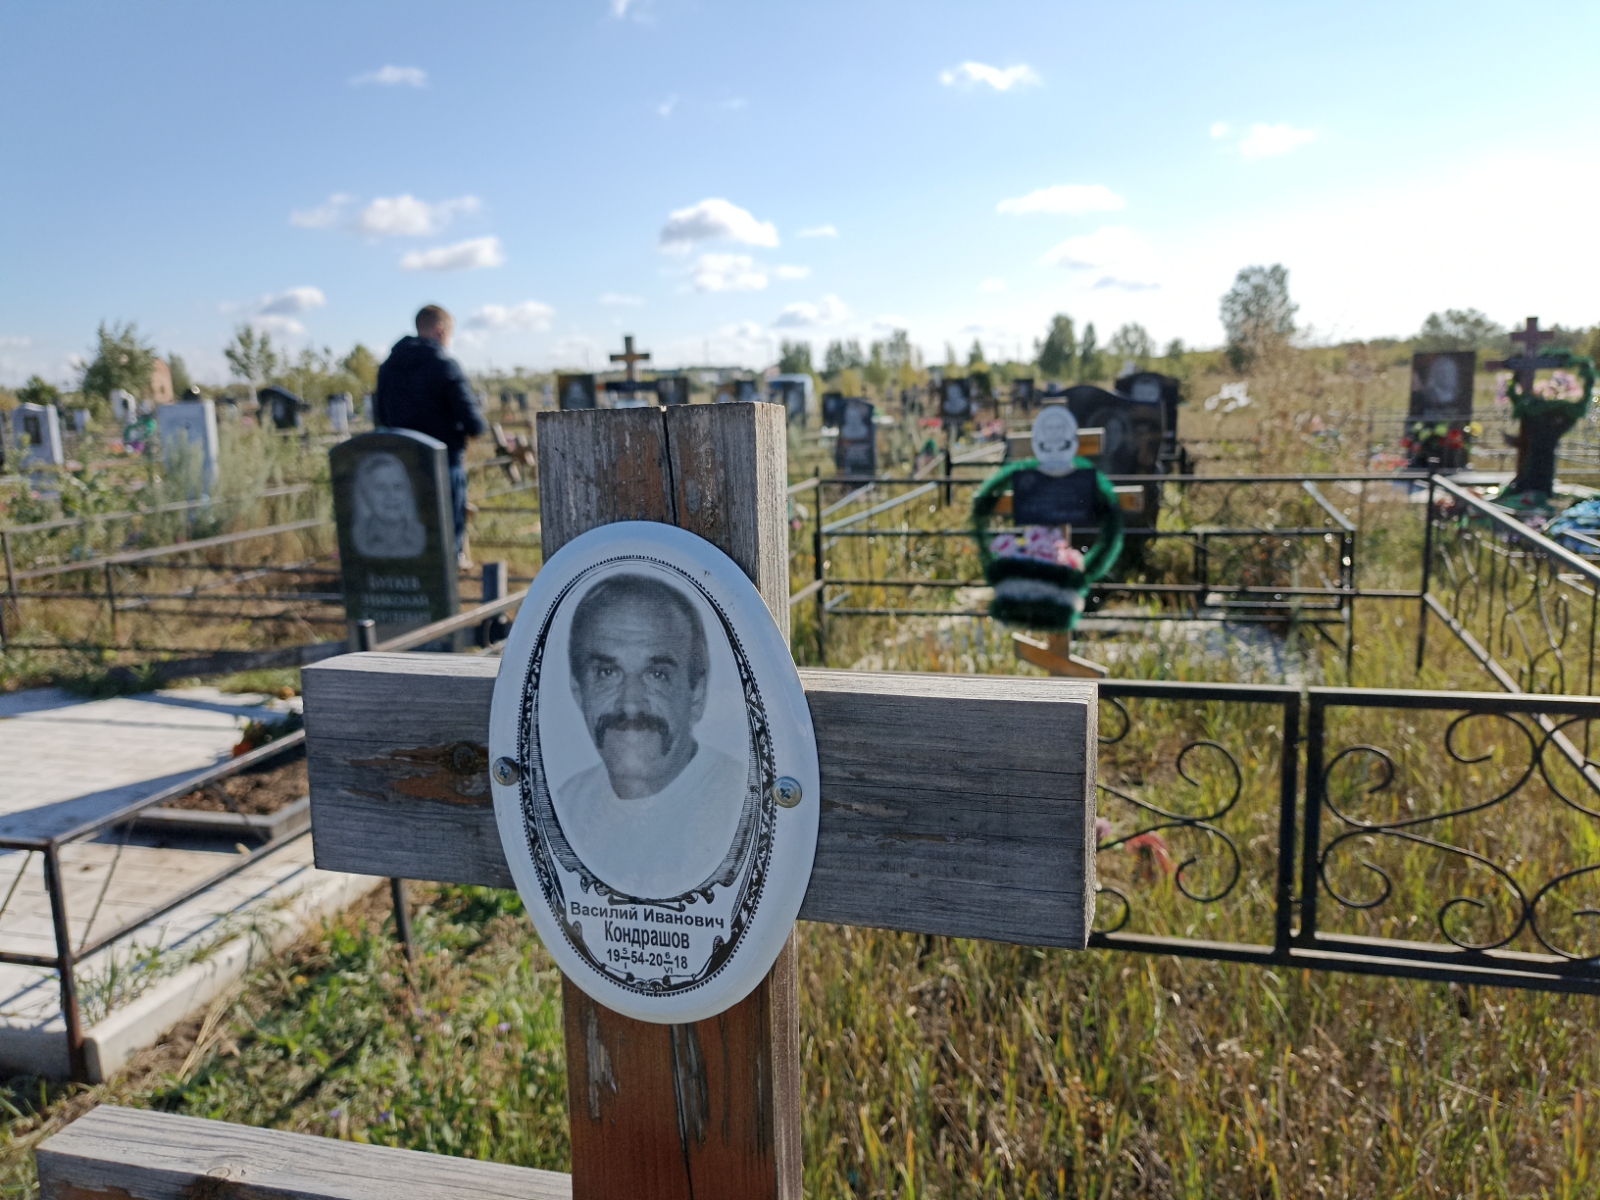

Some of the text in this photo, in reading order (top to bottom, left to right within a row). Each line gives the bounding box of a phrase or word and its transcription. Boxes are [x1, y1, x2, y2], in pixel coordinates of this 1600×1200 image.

[570, 901, 725, 929] Василий Иванович
[604, 920, 690, 949] Кондрашов
